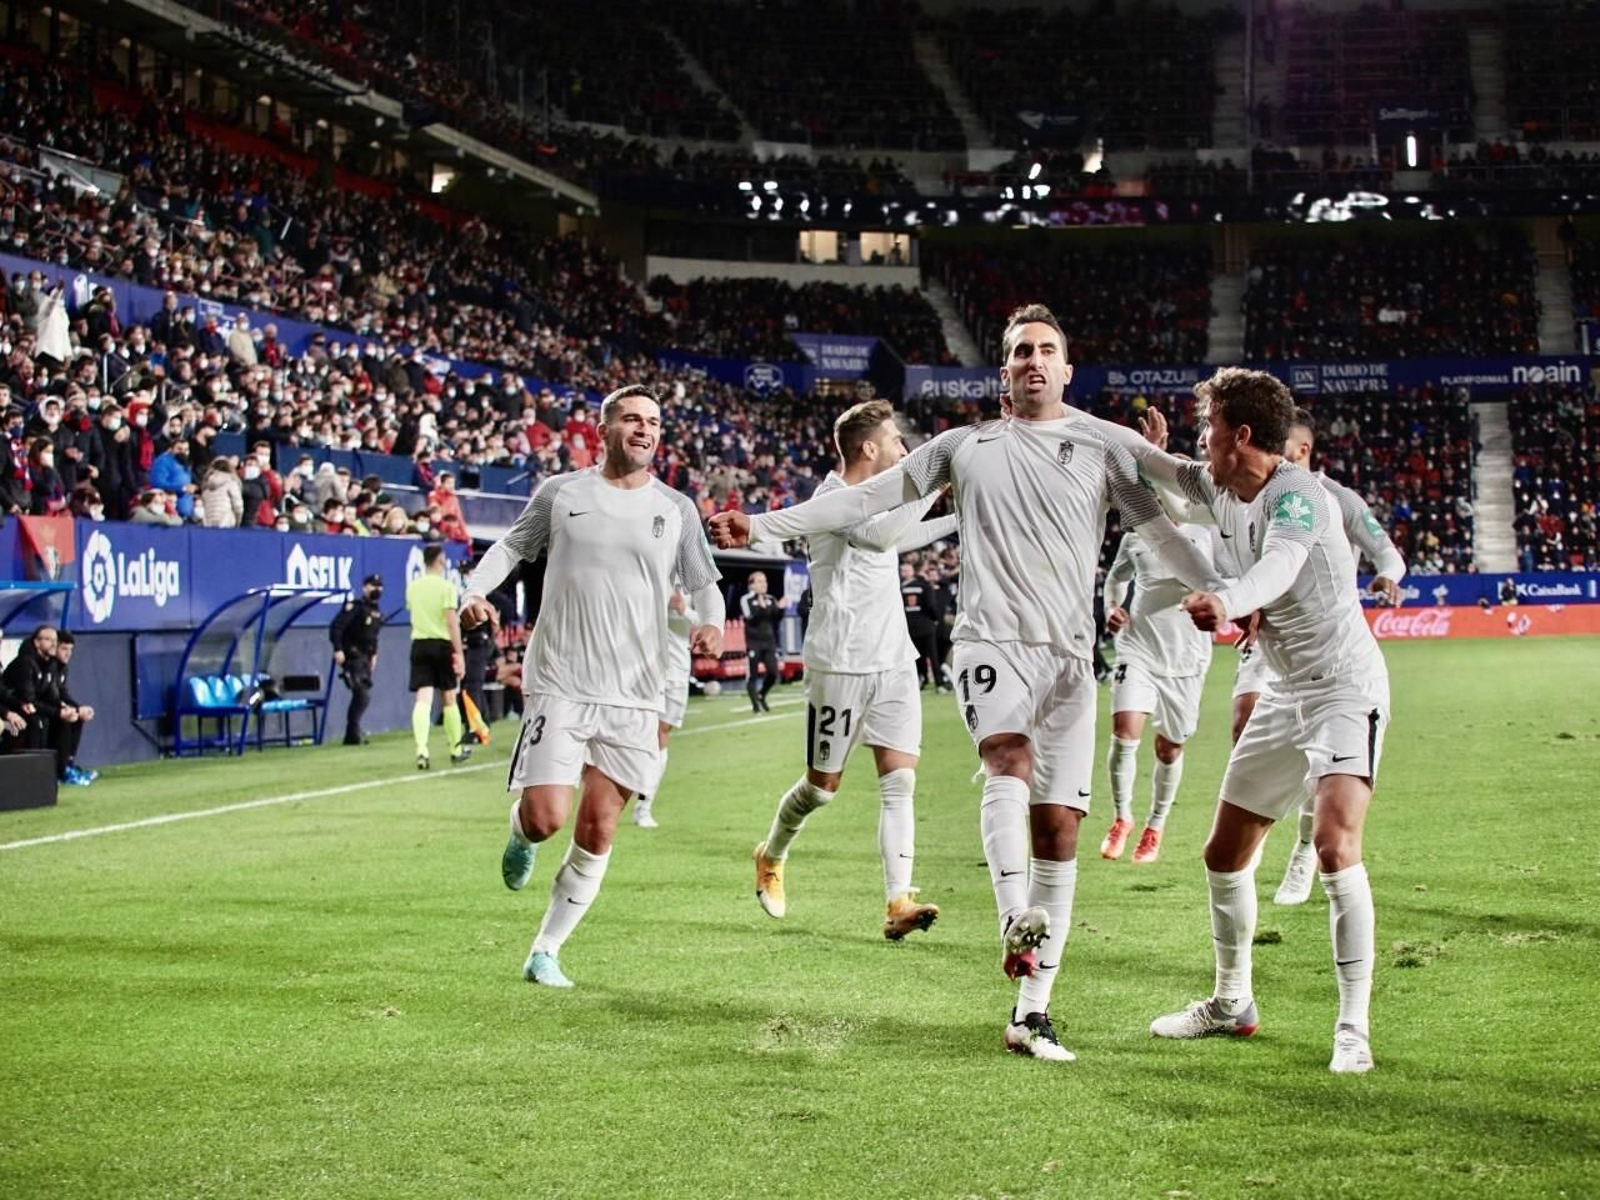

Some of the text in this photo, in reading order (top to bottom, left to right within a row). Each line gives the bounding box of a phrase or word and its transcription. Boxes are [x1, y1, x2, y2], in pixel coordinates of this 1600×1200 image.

[1129, 370, 1186, 385] OTAZU
[1321, 363, 1388, 377] DIARIO DE
[117, 547, 180, 608] LaLiga
[958, 664, 998, 703] 19
[818, 705, 852, 738] 21
